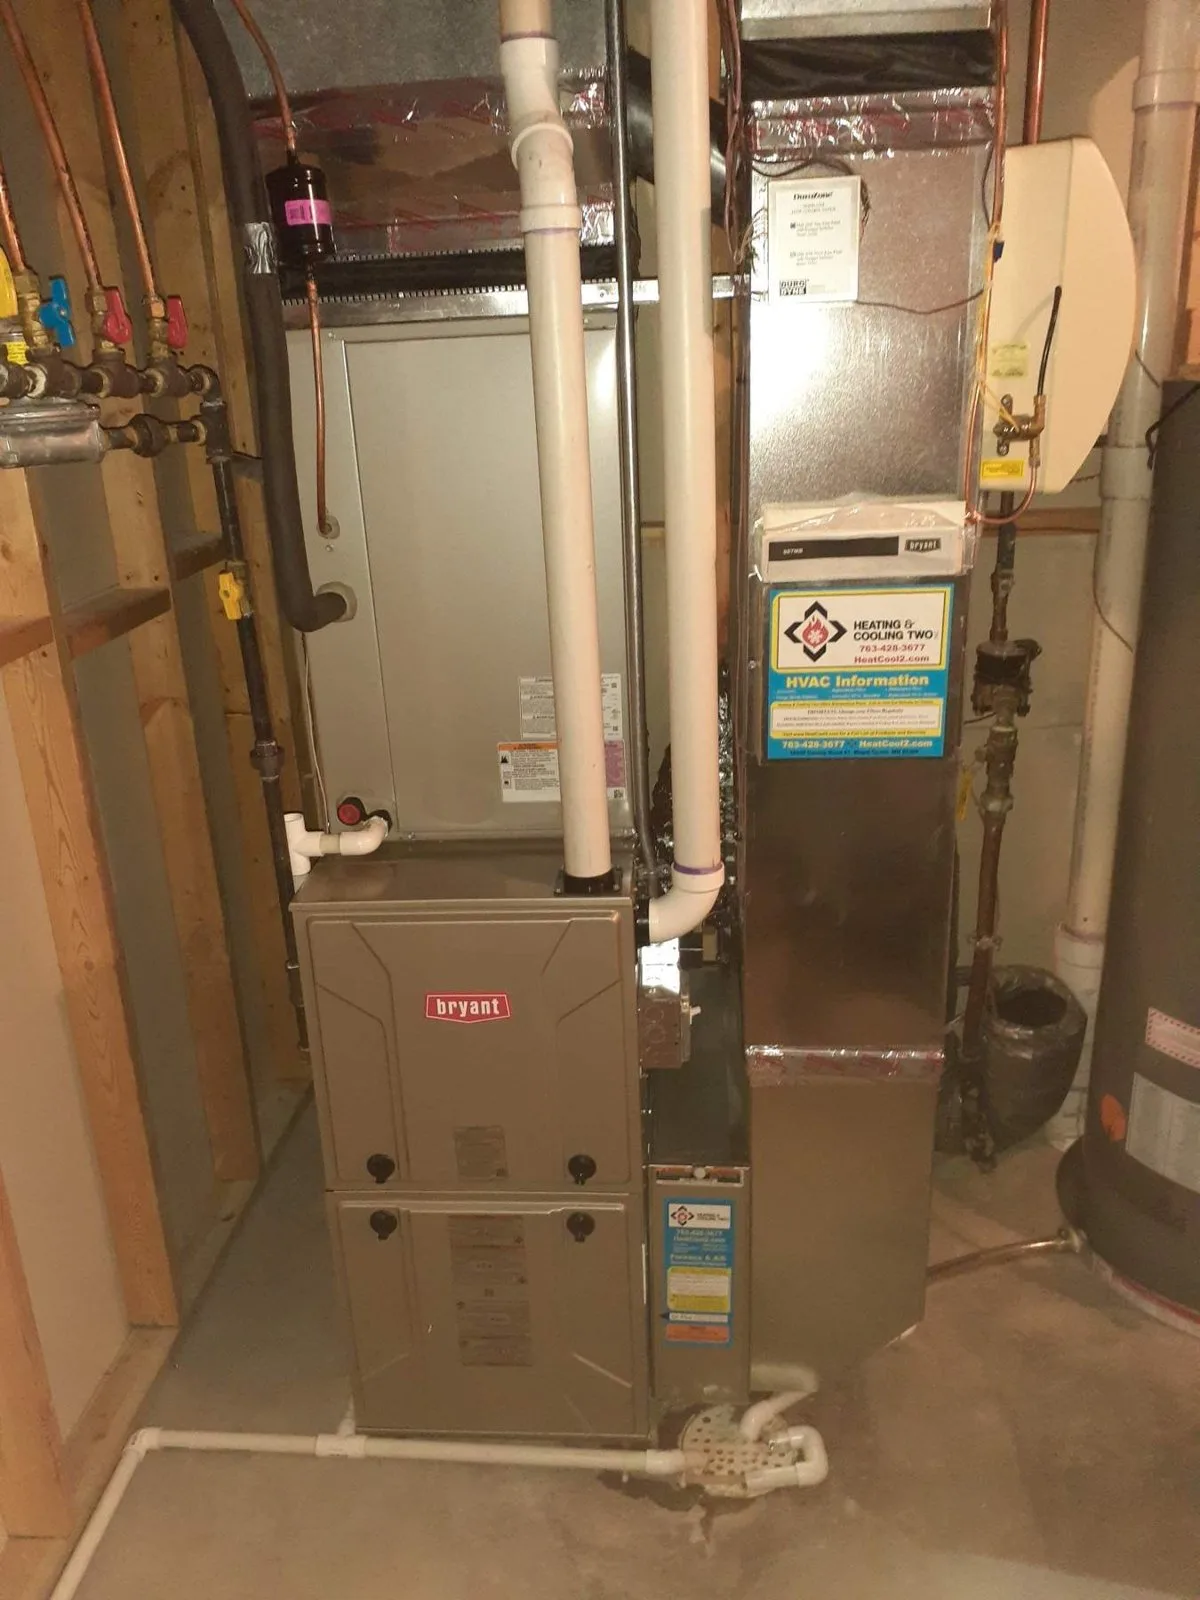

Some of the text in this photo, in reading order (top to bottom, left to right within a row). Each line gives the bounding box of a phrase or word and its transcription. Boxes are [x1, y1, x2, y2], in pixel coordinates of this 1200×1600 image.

[910, 540, 937, 551] bryant
[853, 619, 915, 630] HEATING &
[853, 630, 904, 641] COOLING
[907, 630, 933, 640] TWO
[859, 644, 925, 653] 763-428-3677
[854, 655, 929, 664] HeatCool2.com
[786, 674, 929, 688] HVAC Information
[782, 740, 933, 749] 763-428-3677 HeatCool2.com
[436, 998, 500, 1018] bryant
